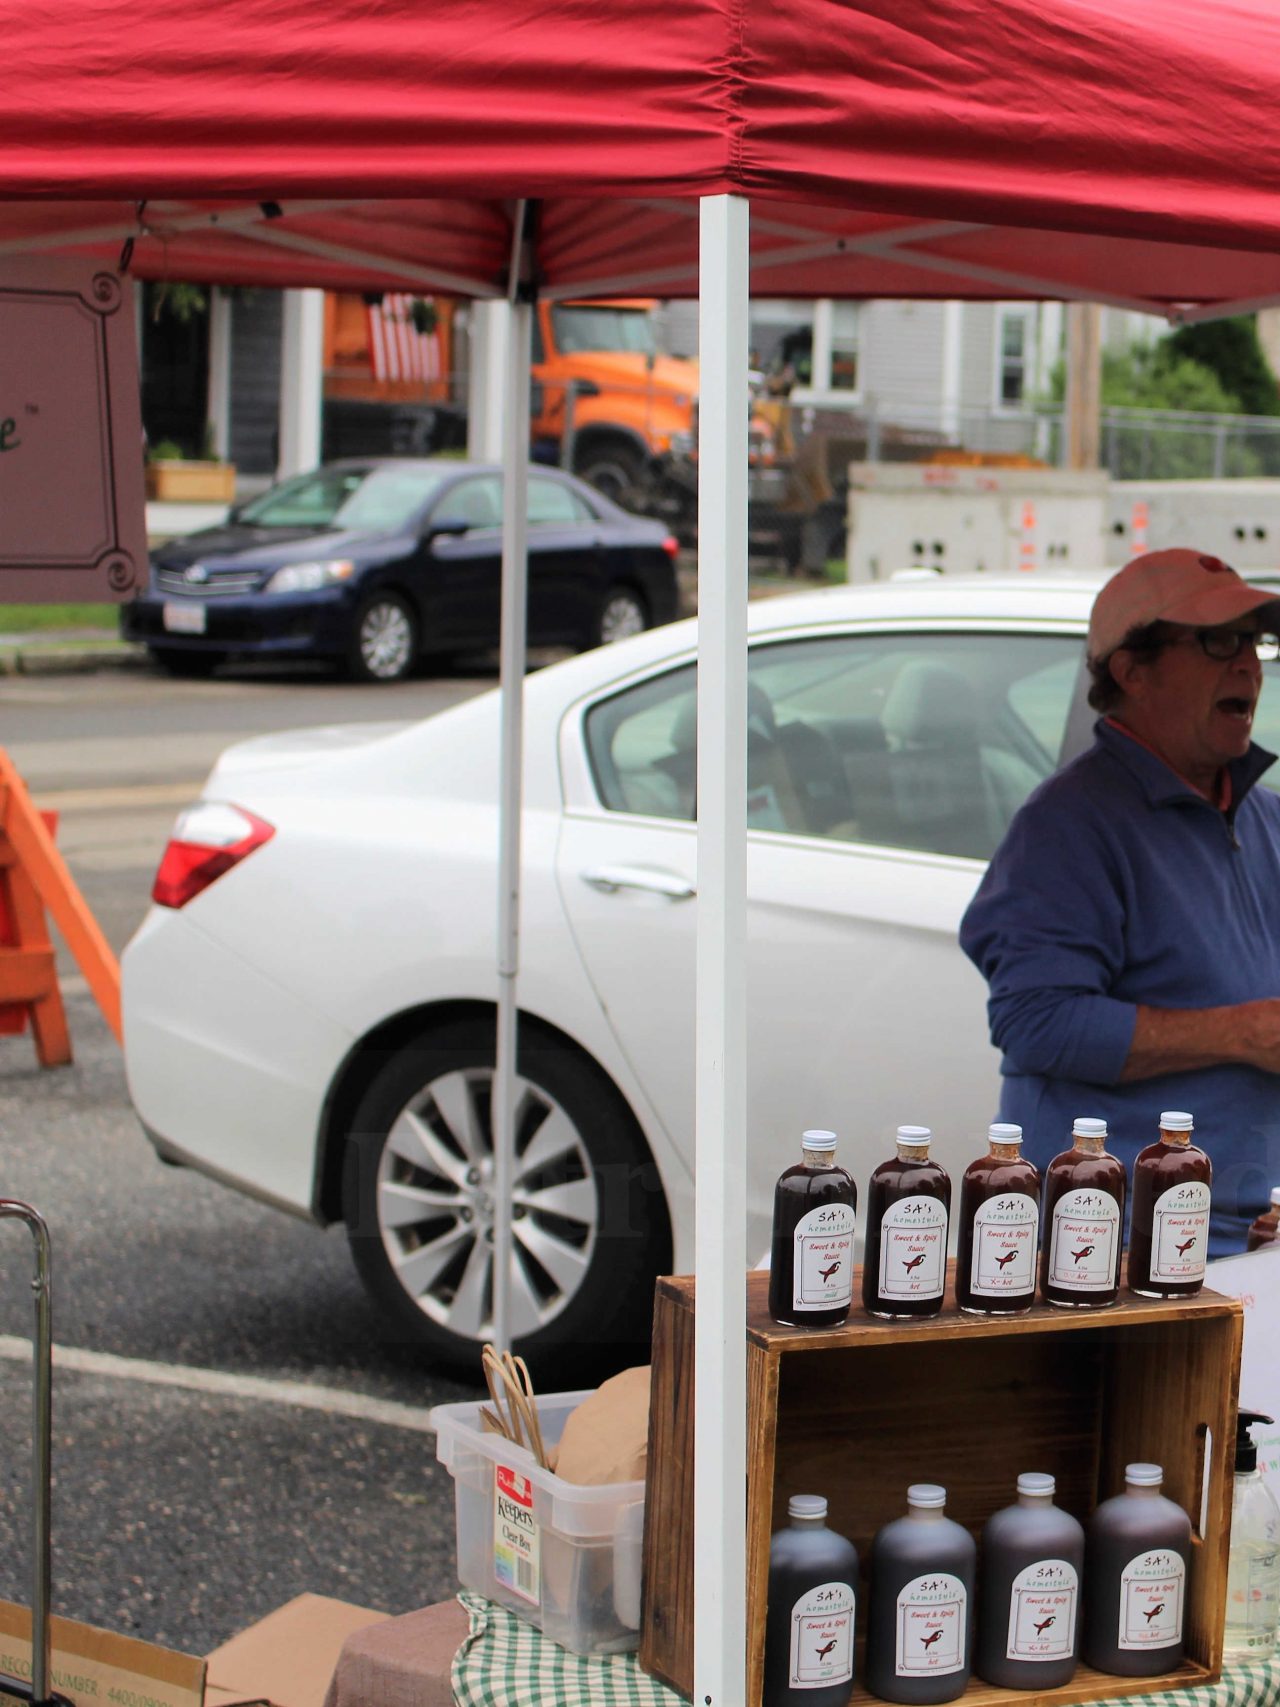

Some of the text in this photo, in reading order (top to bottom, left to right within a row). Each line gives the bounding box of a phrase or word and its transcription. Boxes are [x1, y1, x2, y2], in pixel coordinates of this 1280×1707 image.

[1177, 1189, 1202, 1199] SA's
[996, 1200, 1024, 1211] SA's
[1074, 1195, 1102, 1206] SA's
[903, 1203, 932, 1214] SA's
[818, 1210, 845, 1222] SA's
[1063, 1224, 1081, 1232] Sweet
[831, 1242, 836, 1250] &
[497, 1495, 534, 1527] Keepers
[502, 1523, 518, 1544] Clear
[1144, 1555, 1170, 1566] SA's
[1036, 1567, 1063, 1578] SA's
[920, 1581, 948, 1592] SA's
[816, 1590, 842, 1602] SA's
[1, 1655, 33, 1678] RECO
